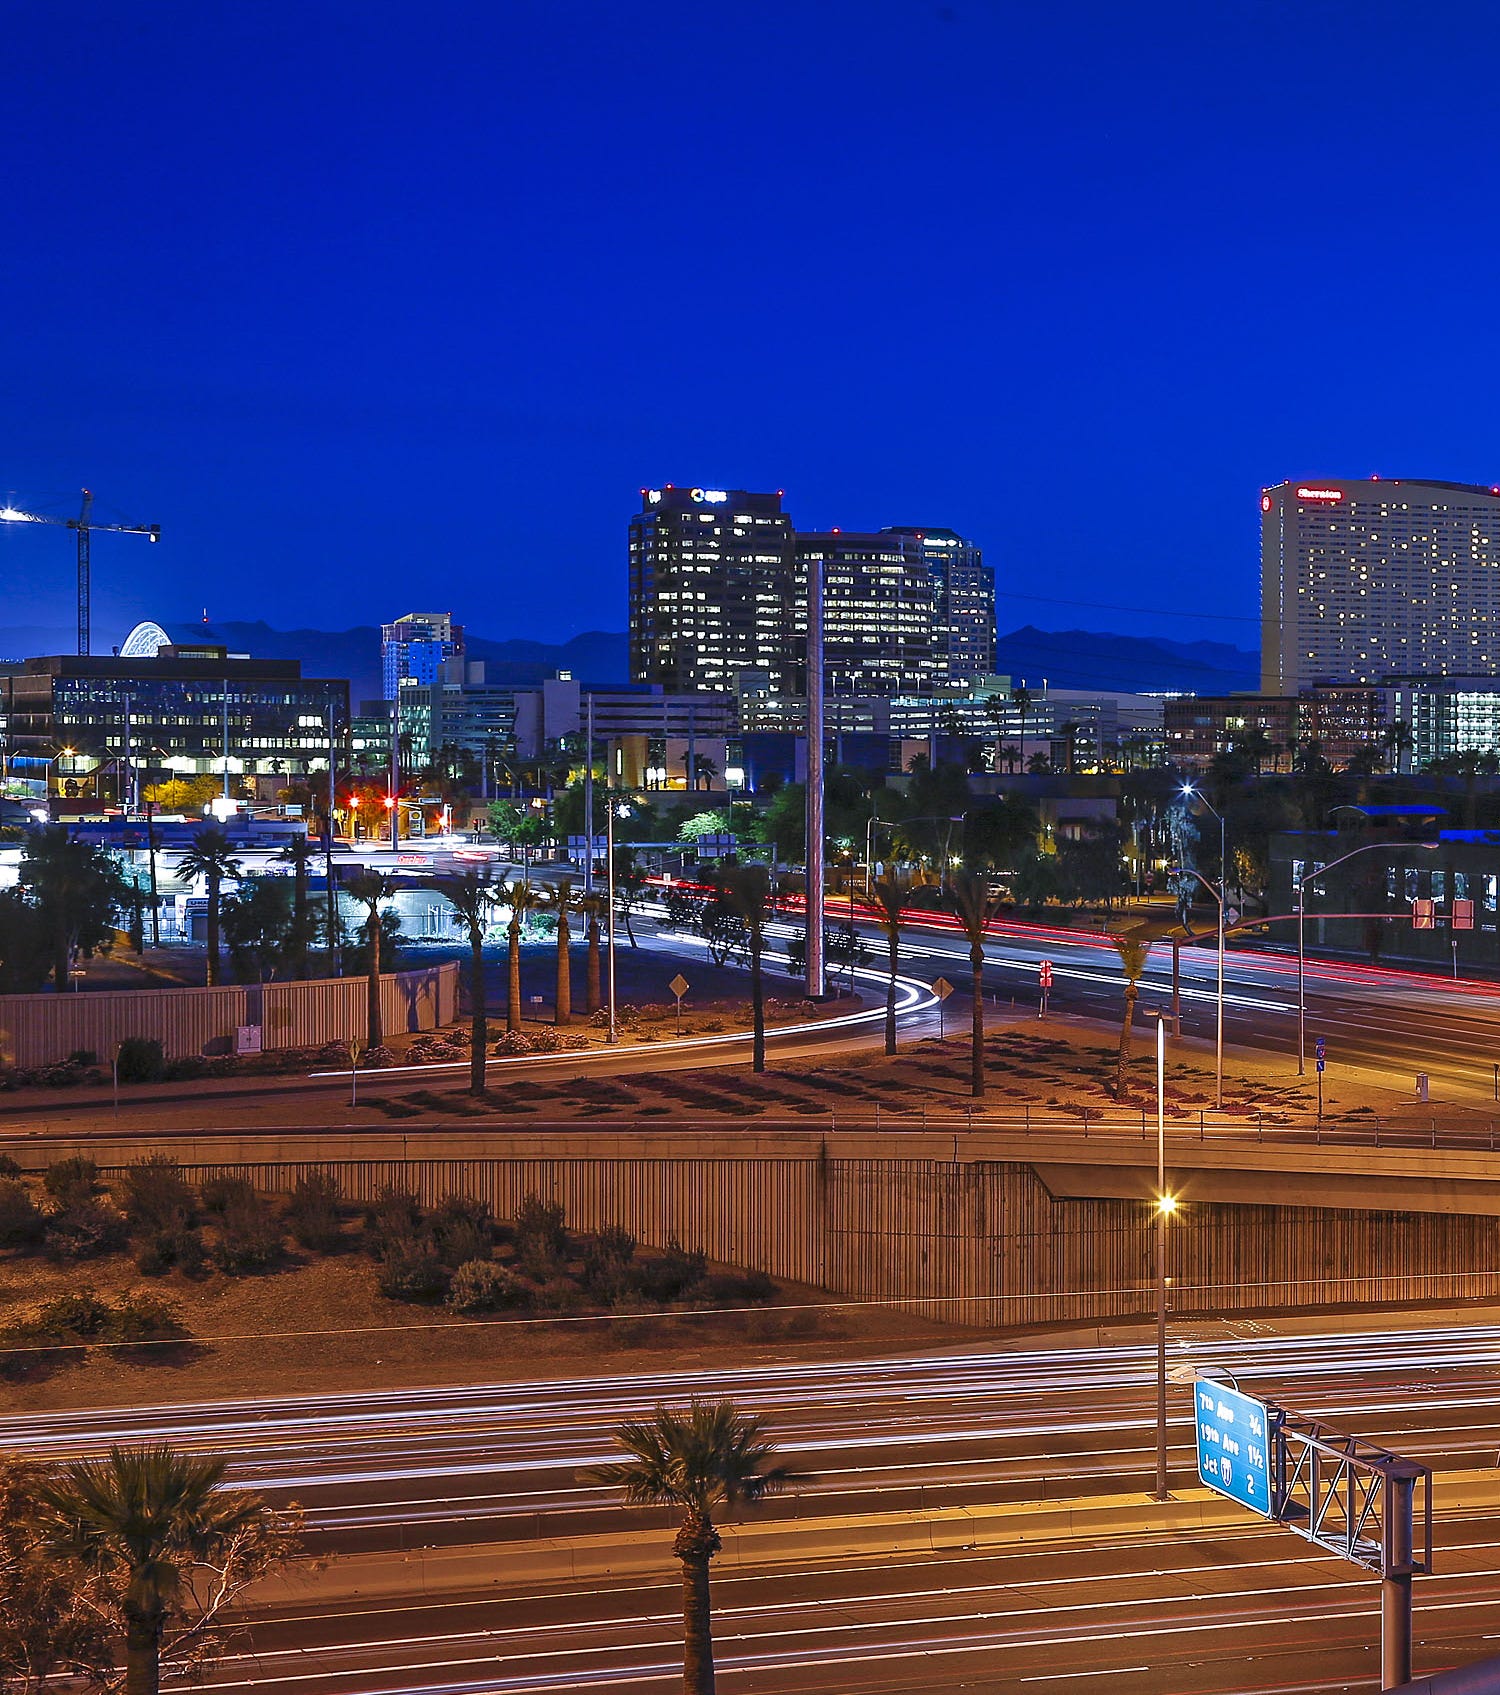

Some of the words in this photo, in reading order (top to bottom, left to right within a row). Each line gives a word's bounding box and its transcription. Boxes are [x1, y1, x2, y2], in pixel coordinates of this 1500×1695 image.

[1297, 488, 1342, 499] Sheraton
[1199, 1391, 1214, 1413] 7th
[1216, 1400, 1234, 1424] Ave
[1201, 1422, 1220, 1444] 19th
[1222, 1432, 1240, 1457] Ave
[1203, 1453, 1219, 1475] Jct
[1246, 1473, 1255, 1495] 2
